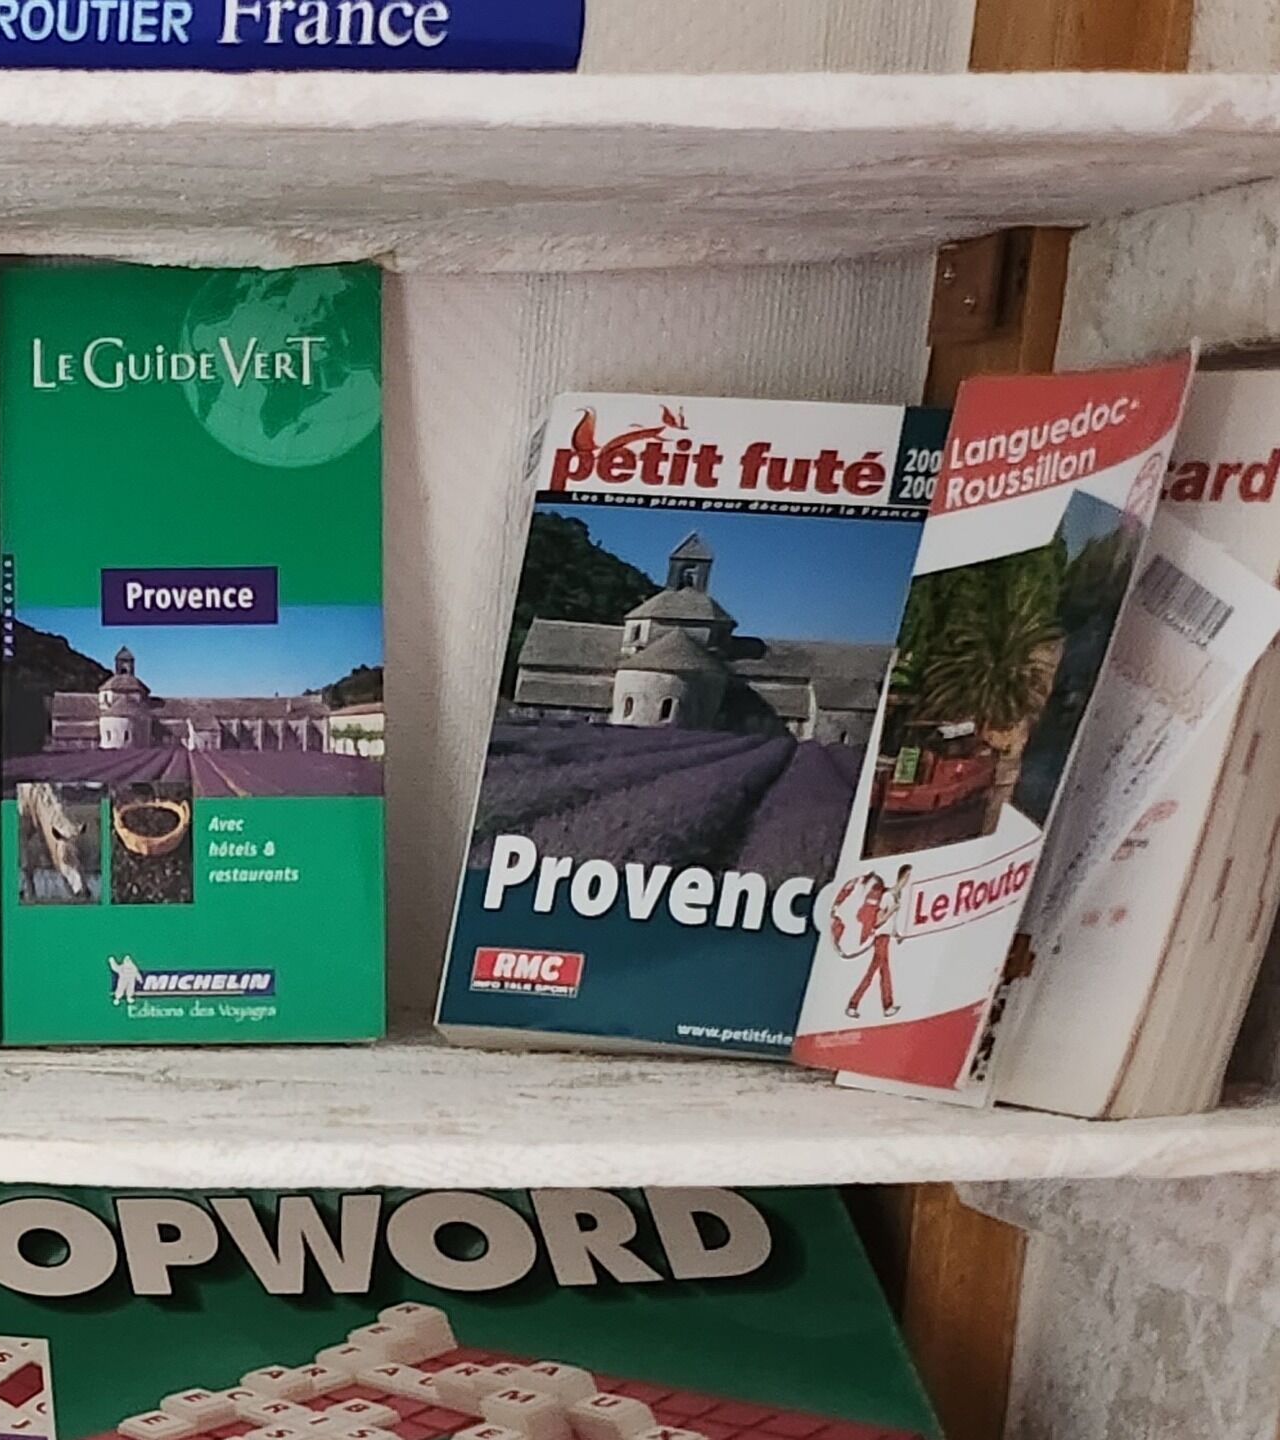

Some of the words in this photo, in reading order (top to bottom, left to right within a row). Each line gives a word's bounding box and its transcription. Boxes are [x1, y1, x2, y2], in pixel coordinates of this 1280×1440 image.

[217, 0, 450, 47] France
[950, 396, 1140, 470] Languedoc-
[549, 438, 724, 492] petit
[739, 441, 887, 497] futé
[944, 446, 1096, 509] Roussillon
[571, 491, 597, 503] Les
[604, 493, 645, 506] bons
[650, 495, 696, 510] plans
[701, 499, 740, 512] pour
[748, 501, 833, 515] découvrir
[863, 504, 921, 519] France
[125, 582, 254, 610] Provence
[208, 816, 244, 832] Avec
[208, 841, 258, 857] hôtels
[208, 866, 300, 883] restaurants
[482, 834, 824, 936] Provenc
[913, 883, 945, 926] Le
[492, 952, 565, 982] RMC
[142, 973, 271, 991] MICHELIN
[190, 1001, 215, 1018] des
[219, 1003, 277, 1022] Voyages
